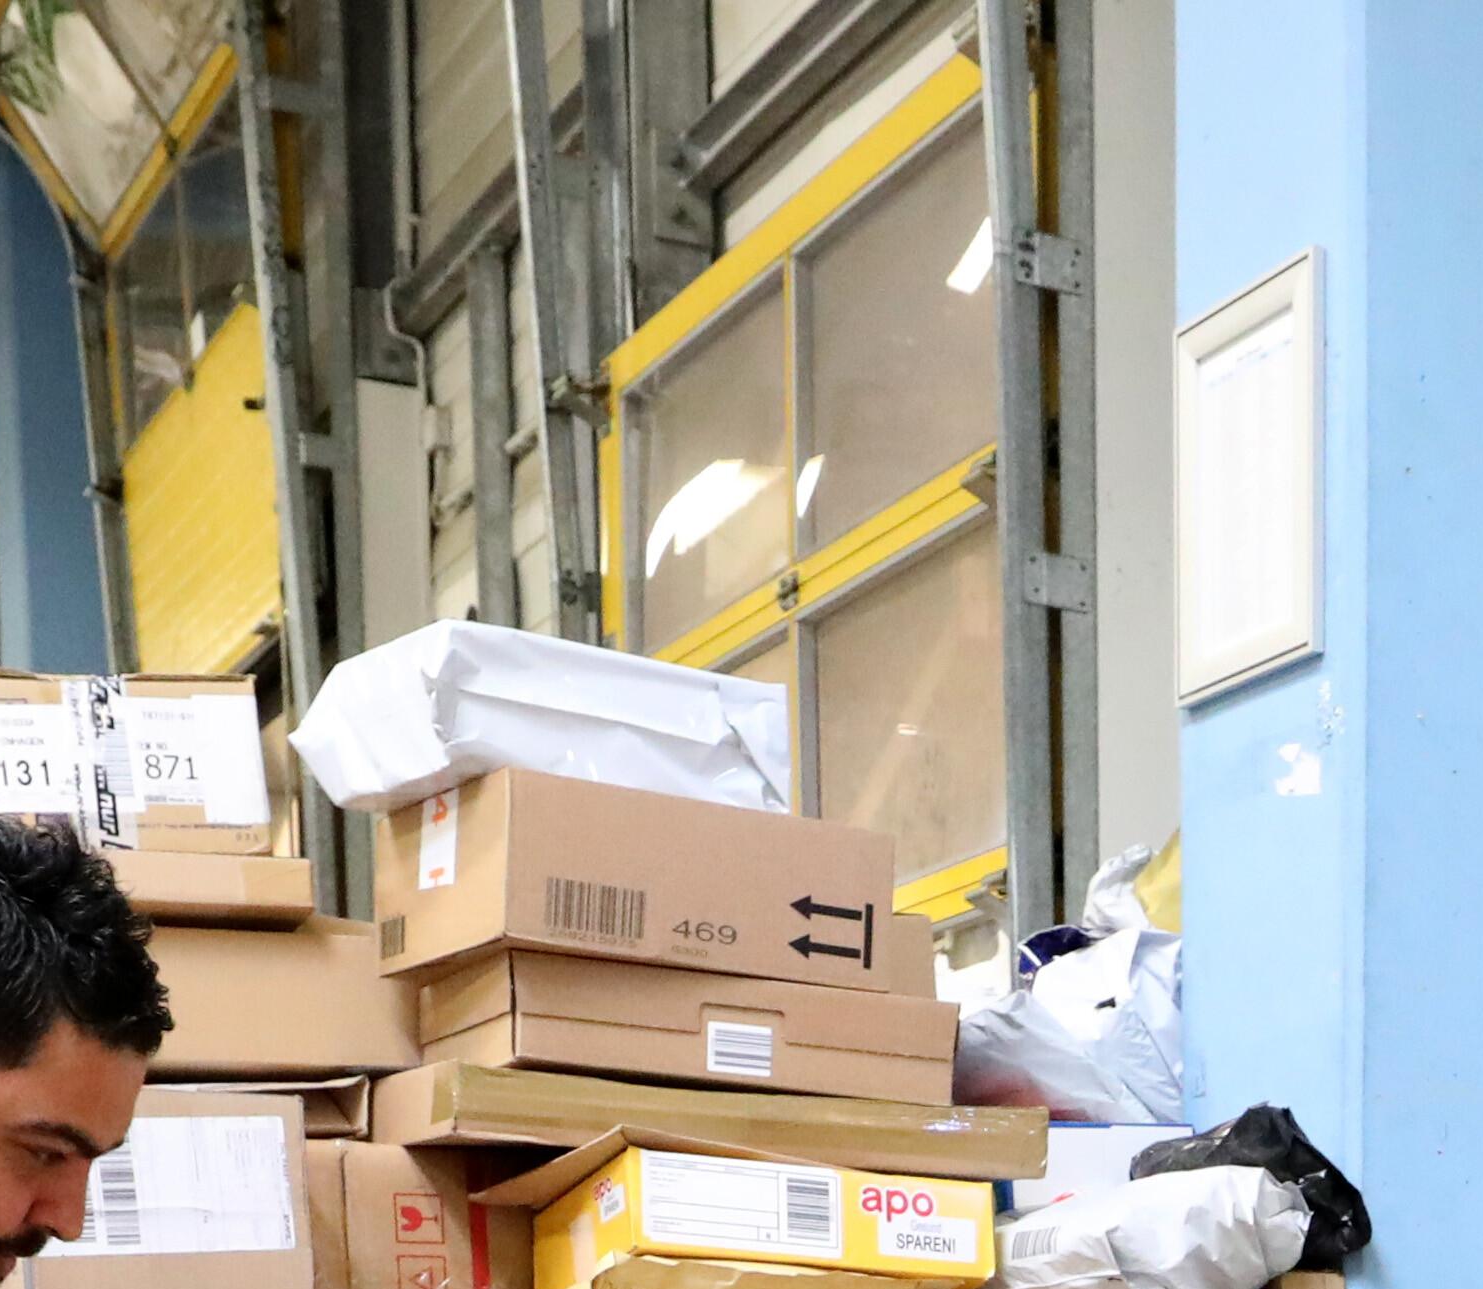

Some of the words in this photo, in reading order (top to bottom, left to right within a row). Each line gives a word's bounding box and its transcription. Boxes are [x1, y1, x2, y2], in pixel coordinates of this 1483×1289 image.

[145, 755, 199, 780] 871
[672, 919, 737, 945] 469
[861, 1184, 935, 1223] apo
